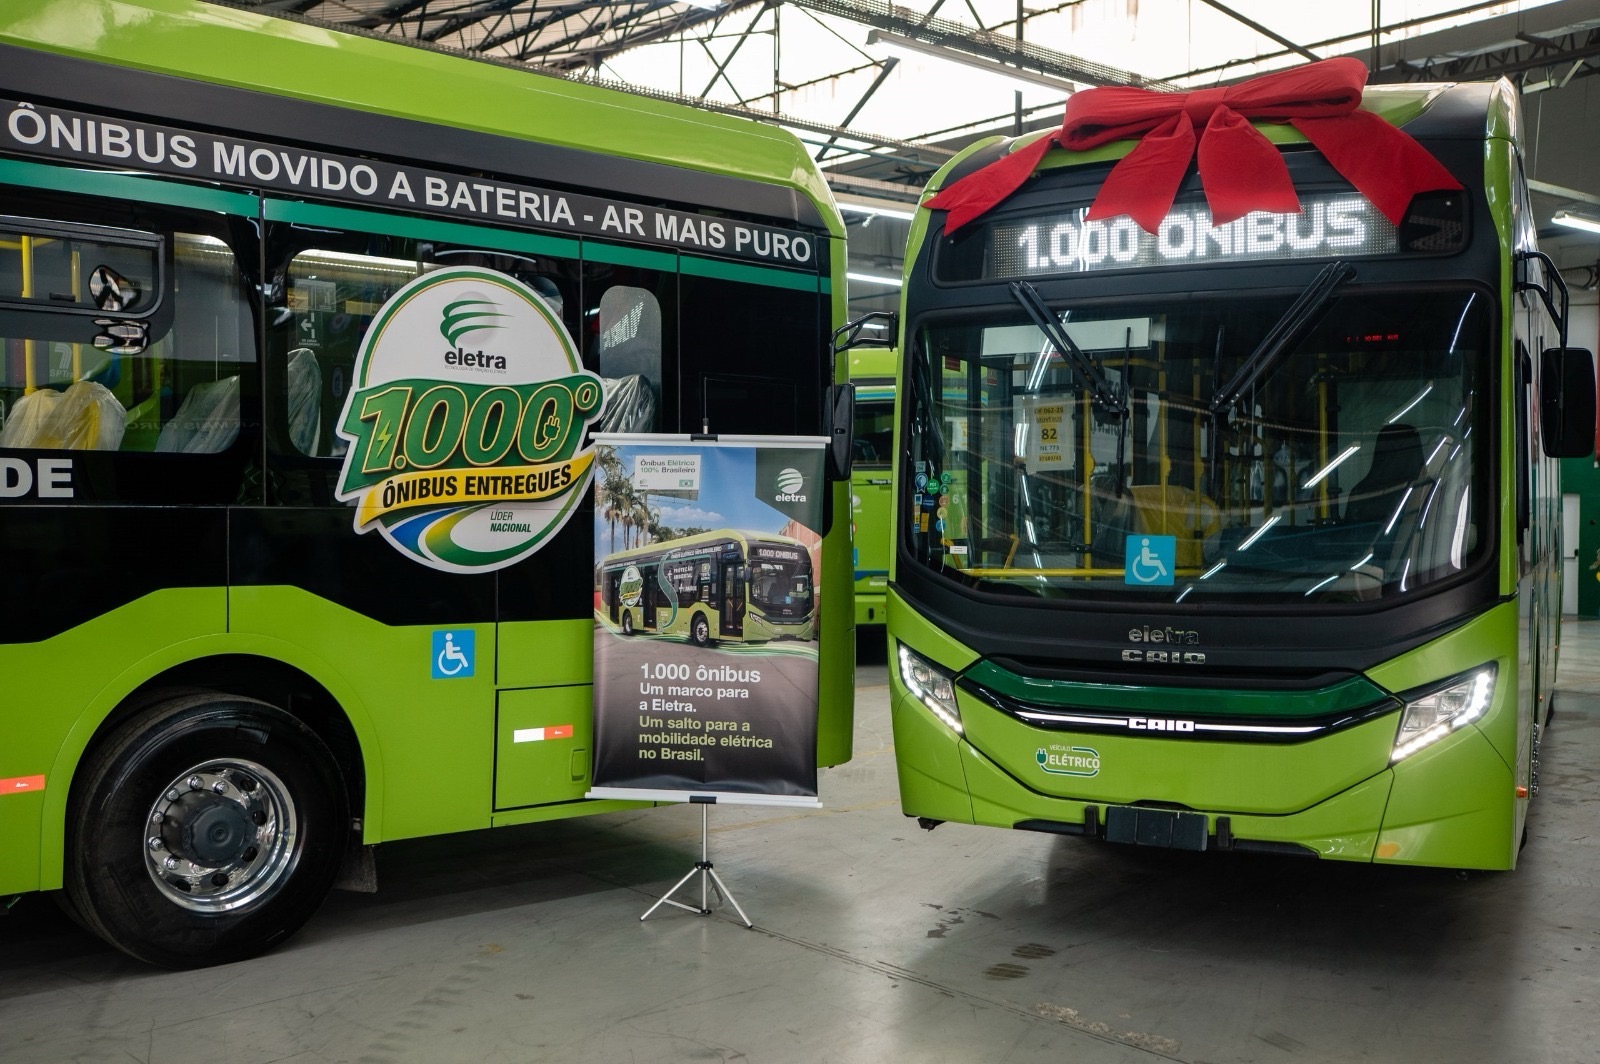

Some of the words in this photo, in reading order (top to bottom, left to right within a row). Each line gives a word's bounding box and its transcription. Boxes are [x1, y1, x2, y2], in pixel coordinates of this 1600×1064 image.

[8, 101, 197, 168] ÔNIBUS
[213, 141, 378, 196] MOVIDO
[388, 171, 416, 203] A
[425, 176, 576, 226] BATERIA
[600, 205, 646, 236] AR
[655, 213, 726, 249] MAIS
[735, 226, 811, 262] PURO
[1019, 215, 1138, 268] 1.000
[444, 347, 506, 369] eletra
[1041, 428, 1057, 440] 82
[383, 475, 458, 508] ÔNIBUS
[465, 464, 572, 495] ENTREGUES
[775, 493, 807, 502] eletra
[490, 510, 514, 521] LÍDER
[490, 523, 532, 532] NACIONAL
[1128, 625, 1200, 645] eletra
[1121, 649, 1206, 665] CAIO
[640, 663, 690, 680] 1.000
[695, 665, 761, 683] ônibus
[640, 682, 664, 696] Um
[668, 686, 713, 697] marco
[717, 687, 749, 700] para
[639, 701, 648, 711] a
[652, 699, 697, 712] Eletra.
[639, 715, 663, 728] Um
[667, 717, 702, 729] salto
[705, 721, 737, 732] para
[741, 722, 750, 732] a
[1128, 717, 1195, 732] CAIO
[639, 732, 717, 746] mobilidade
[720, 735, 773, 748] elétrica
[639, 749, 657, 759] no
[661, 747, 705, 761] Brasil.
[1049, 753, 1101, 769] ELÉTRICO
